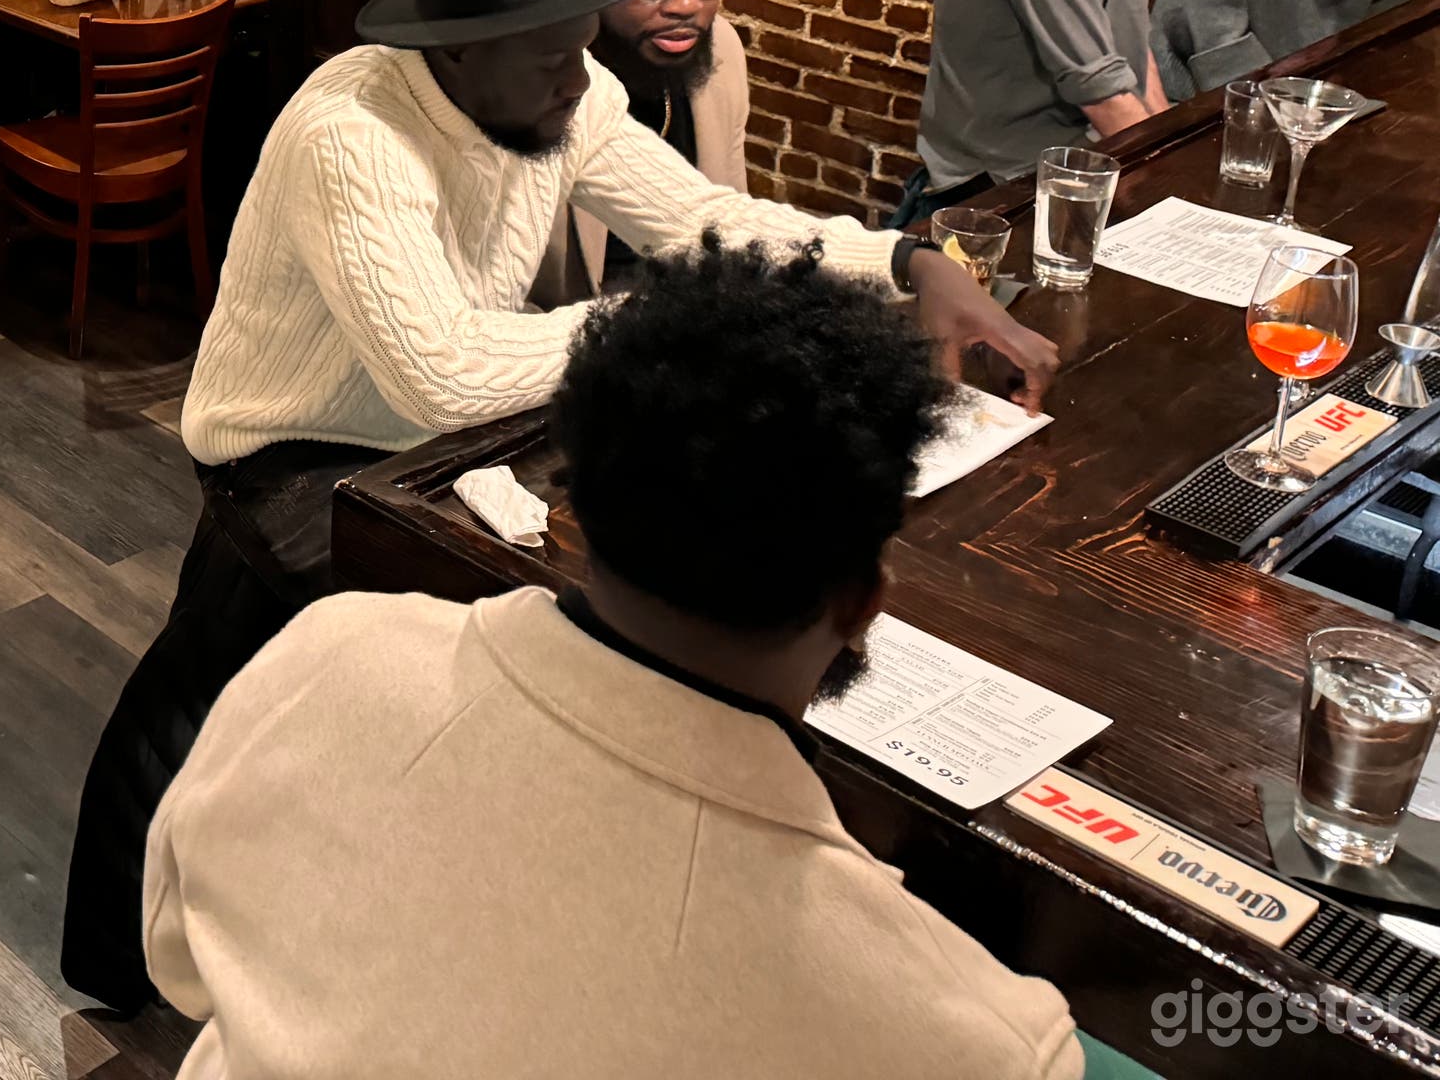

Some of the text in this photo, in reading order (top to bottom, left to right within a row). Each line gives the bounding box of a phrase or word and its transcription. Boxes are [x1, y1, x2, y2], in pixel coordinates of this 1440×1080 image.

[1314, 401, 1367, 432] UFC
[885, 740, 969, 786] $19.95
[1020, 784, 1288, 922] Cuervo UFC
